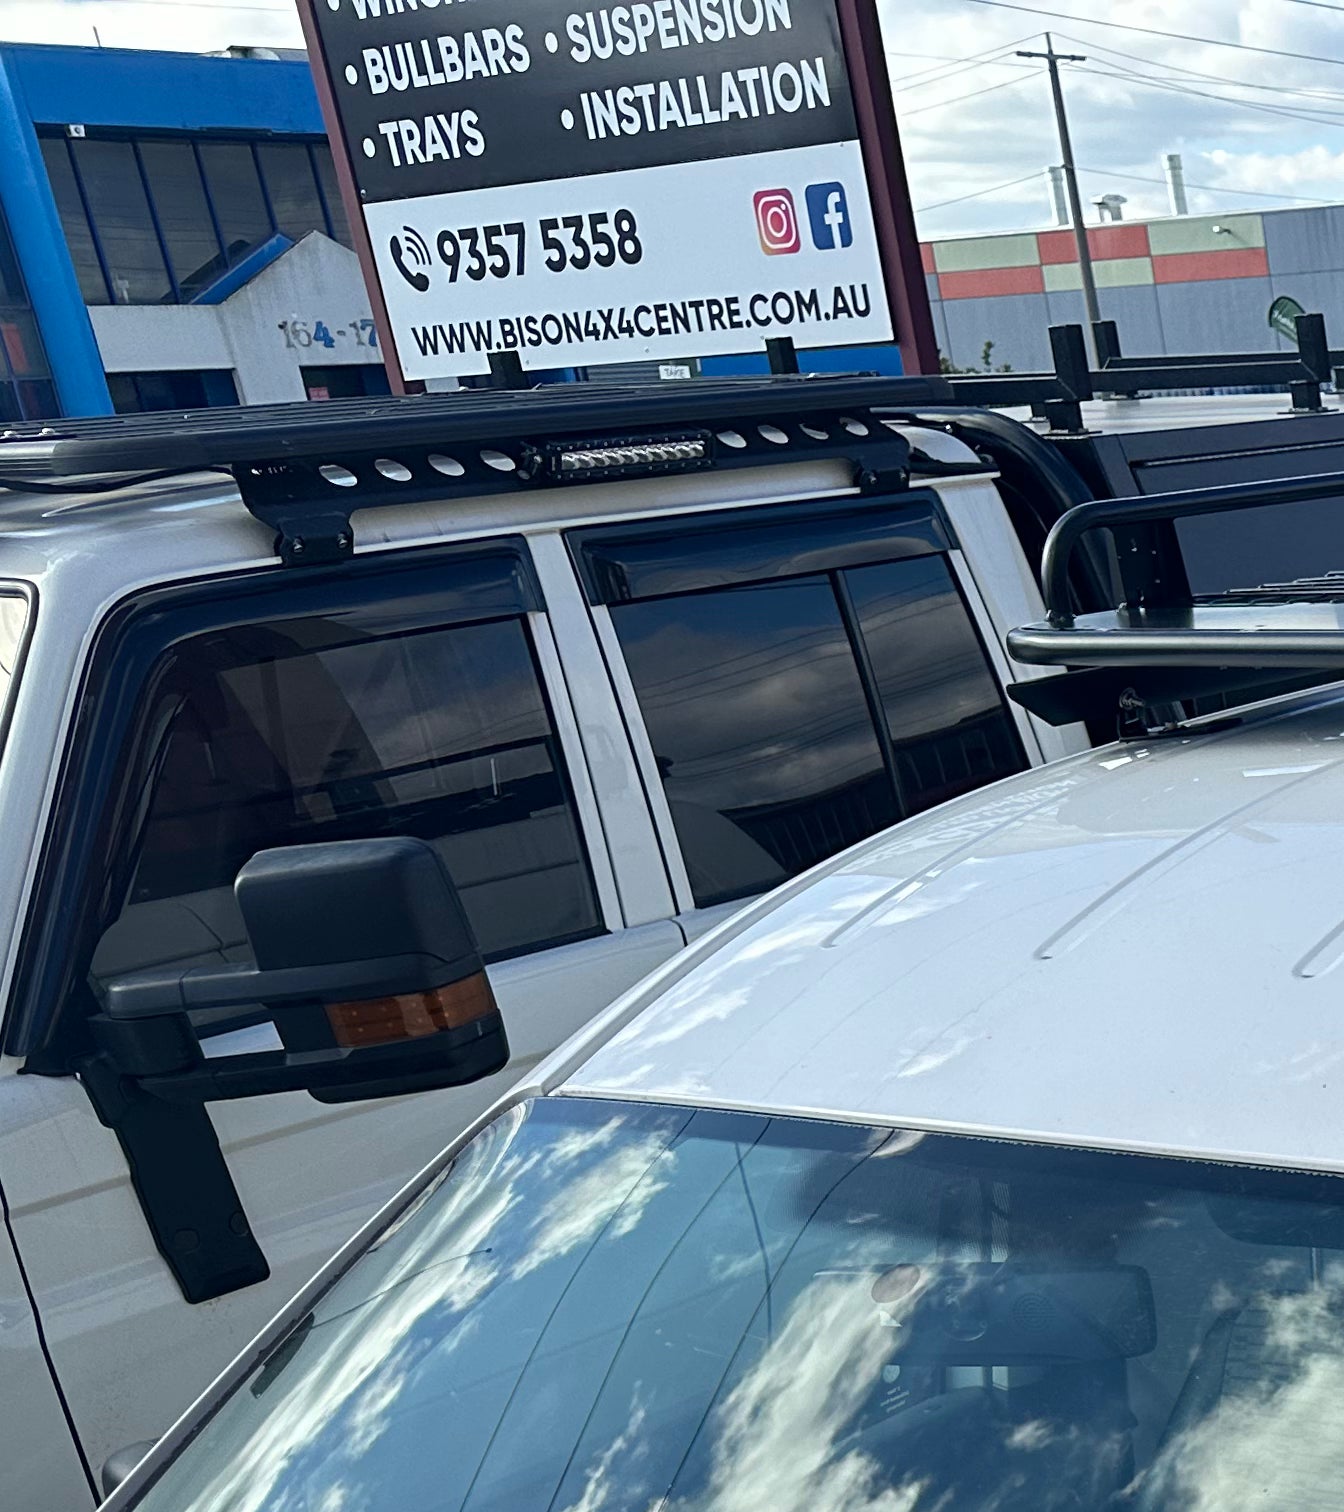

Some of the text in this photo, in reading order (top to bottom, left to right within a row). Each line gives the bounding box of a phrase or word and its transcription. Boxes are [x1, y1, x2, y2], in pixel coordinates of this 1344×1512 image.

[362, 23, 531, 95] BULLBARS
[564, 0, 793, 64] SUSPENSION
[578, 57, 832, 140] INSTALLATION
[379, 109, 486, 167] TRAYS
[436, 208, 643, 283] 9357 5358
[411, 283, 872, 357] WWW.BISON4X4CENTRE.COM.AU
